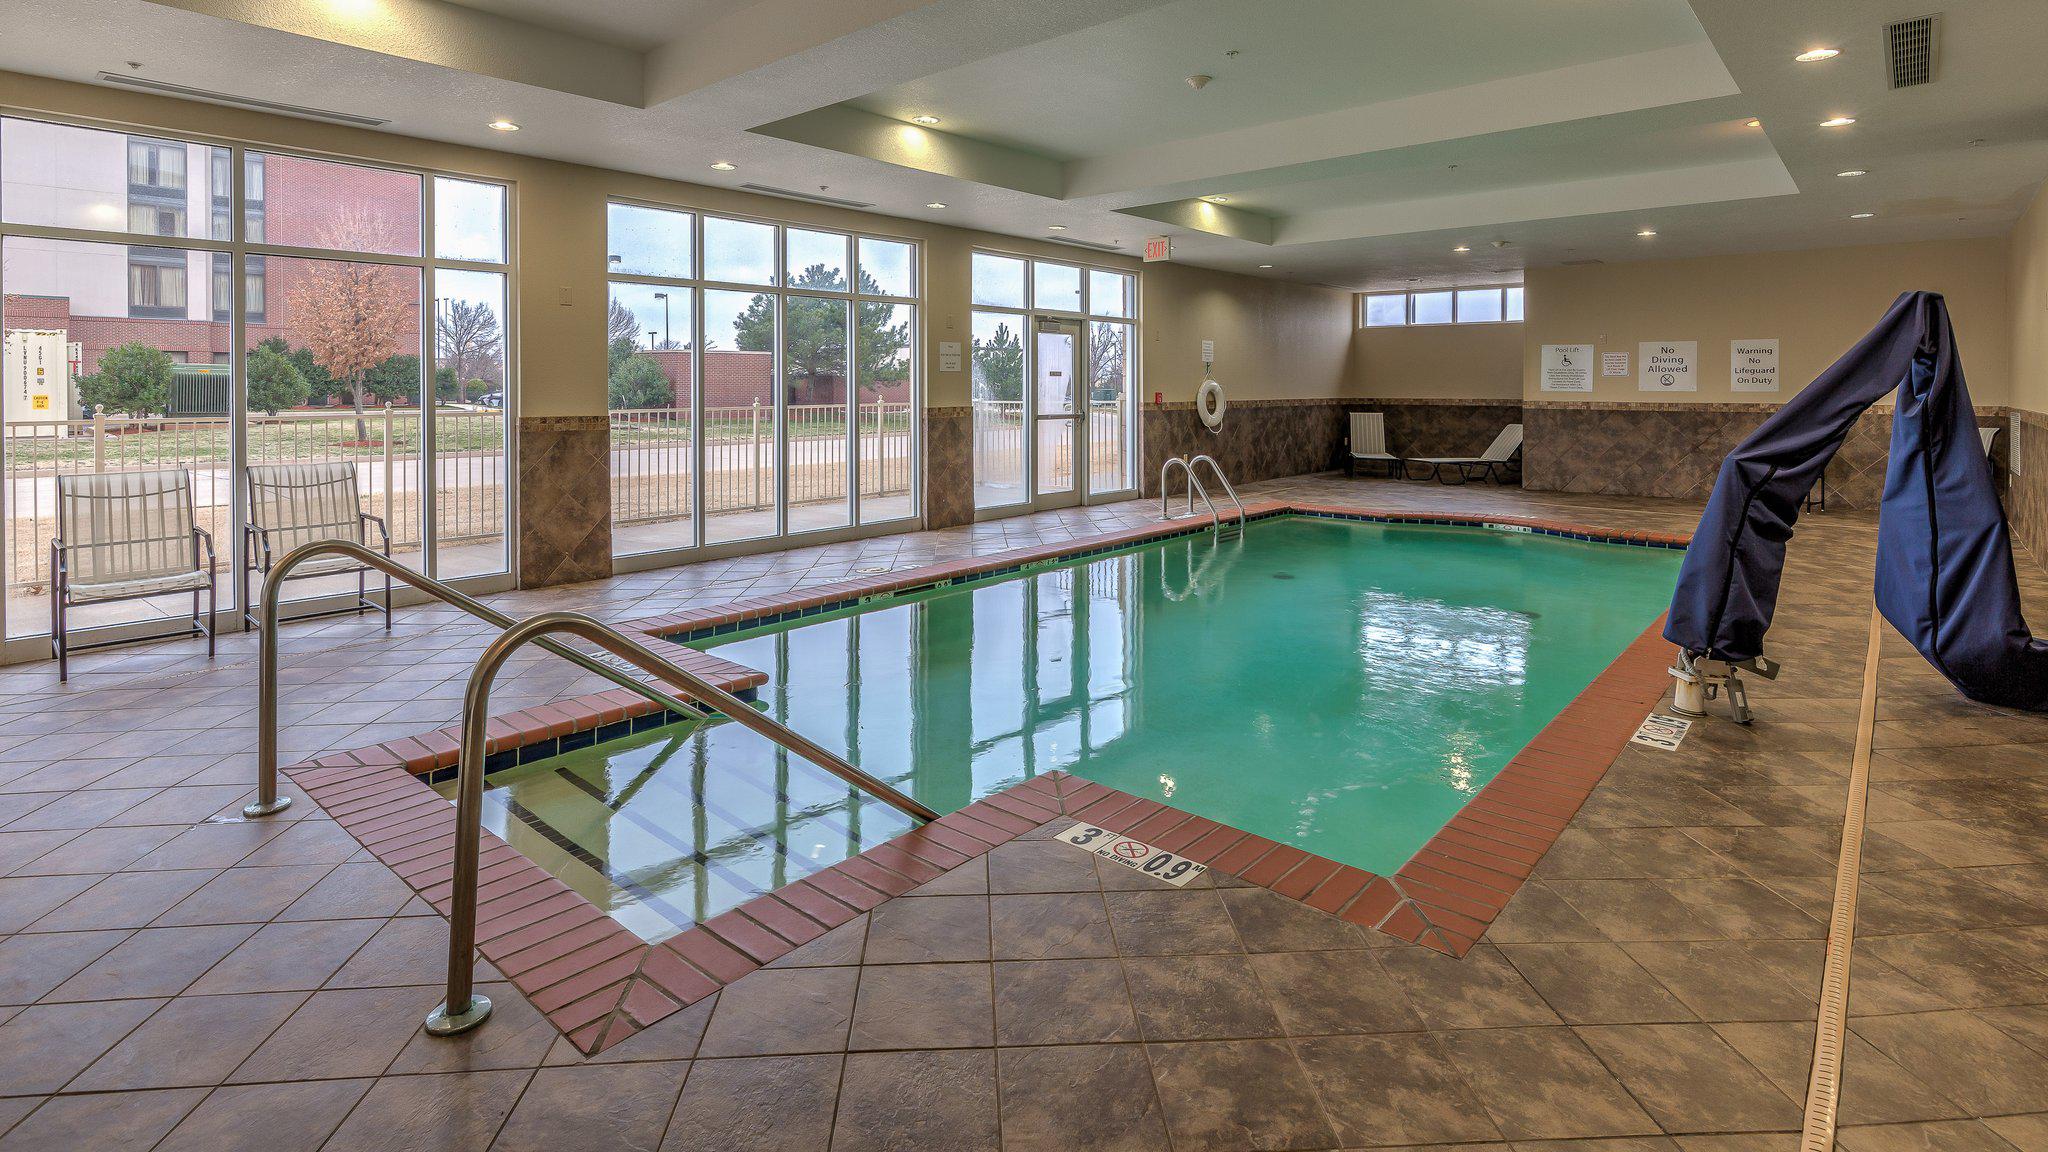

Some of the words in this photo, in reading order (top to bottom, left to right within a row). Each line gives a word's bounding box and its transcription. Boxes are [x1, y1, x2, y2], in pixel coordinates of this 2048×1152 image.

[1147, 240, 1165, 258] EXIT
[1660, 346, 1675, 354] No
[1736, 347, 1773, 355] Warning
[1651, 356, 1684, 365] Diving
[1647, 365, 1688, 373] Allowed
[1734, 367, 1776, 375] Lifeguard
[1751, 377, 1773, 385] Duty
[1070, 827, 1104, 845] 3
[1103, 832, 1118, 840] FT
[1097, 849, 1110, 857] NO
[1109, 854, 1138, 868] DIVING
[1142, 853, 1193, 880] 0.9
[1192, 865, 1205, 873] M
